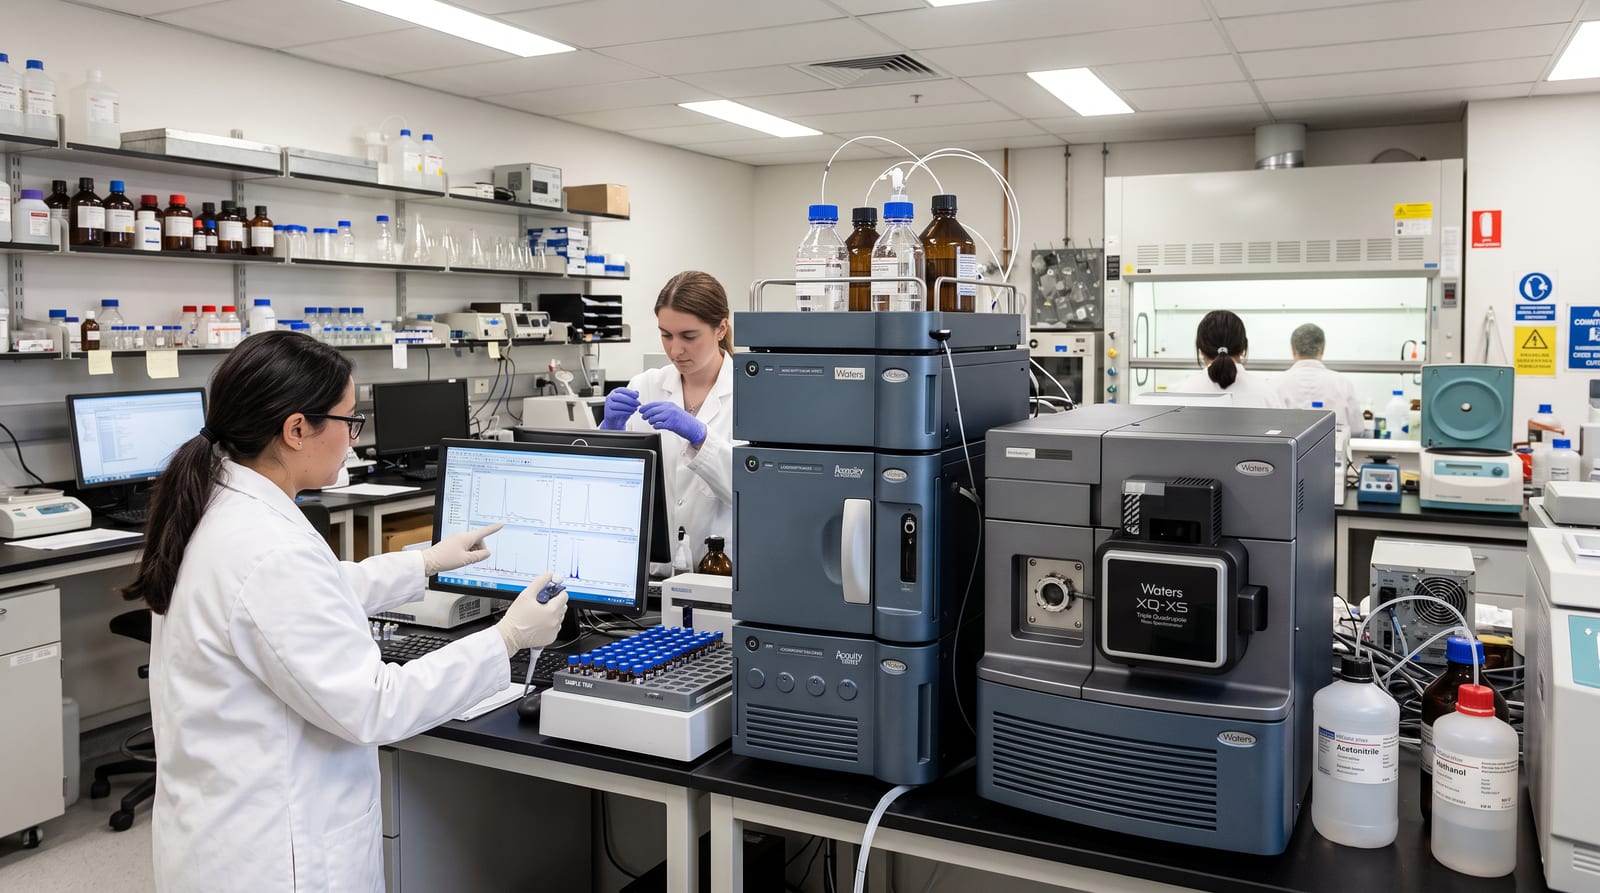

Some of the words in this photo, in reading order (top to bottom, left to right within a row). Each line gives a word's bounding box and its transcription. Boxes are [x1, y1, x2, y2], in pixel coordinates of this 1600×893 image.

[836, 369, 864, 379] Waters
[1240, 463, 1270, 473] Waters
[1140, 582, 1183, 598] Waters
[1136, 597, 1188, 613] XQ-XS
[1136, 611, 1153, 620] Triple
[1152, 613, 1188, 624] Quadrupole
[565, 679, 581, 687] SAMPLE
[1222, 733, 1253, 744] Waters
[1336, 744, 1379, 756] Acetonitrile
